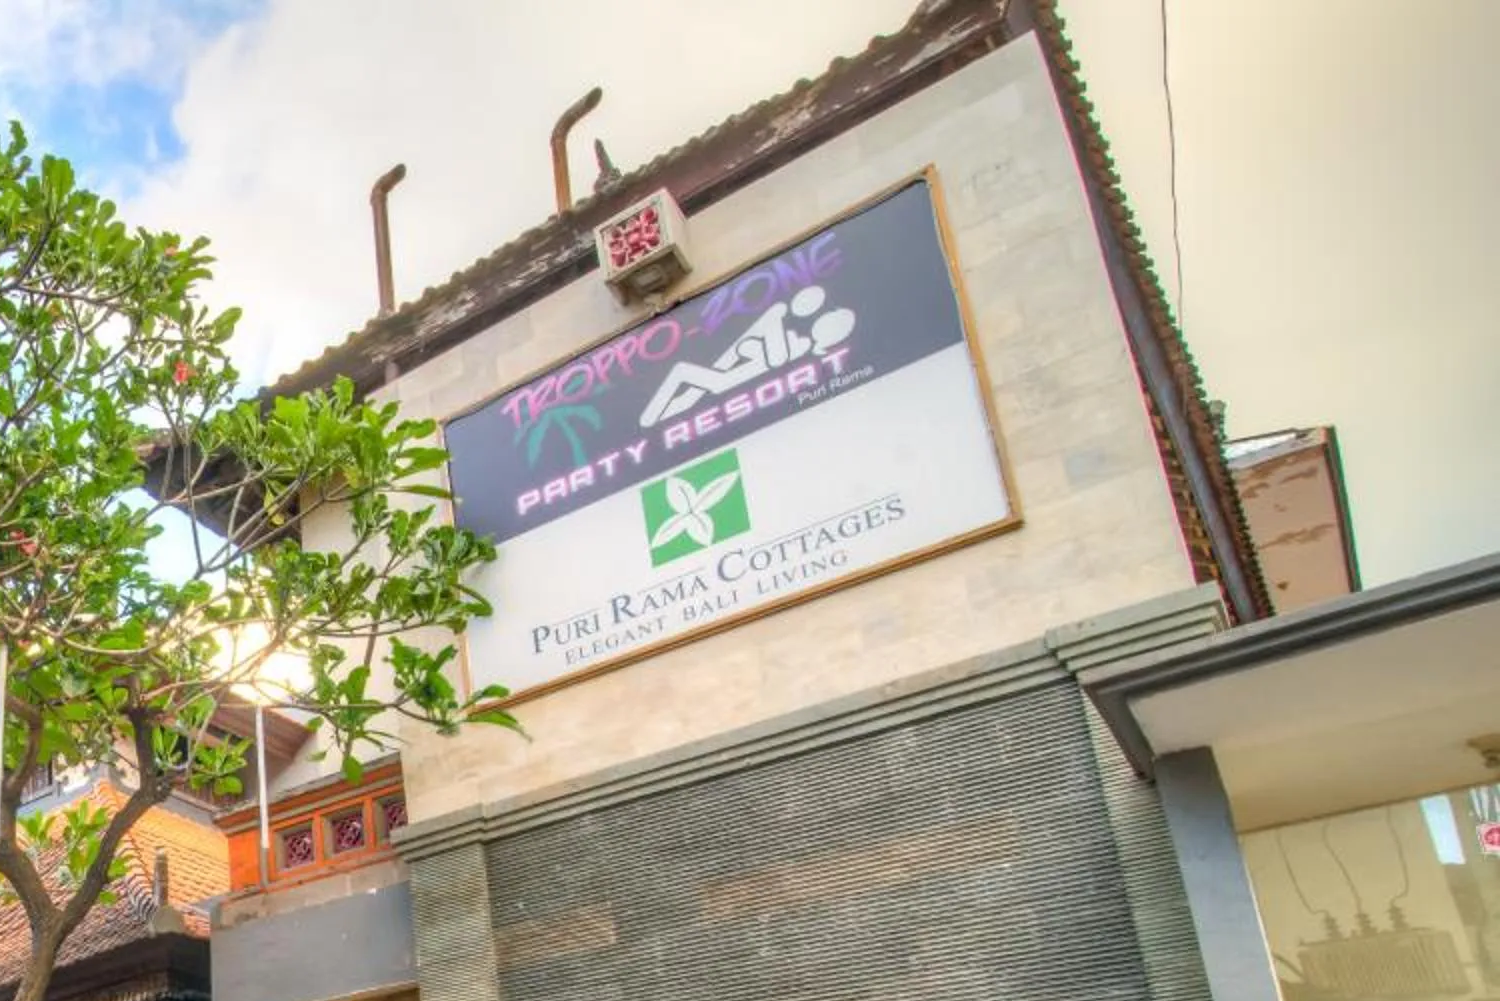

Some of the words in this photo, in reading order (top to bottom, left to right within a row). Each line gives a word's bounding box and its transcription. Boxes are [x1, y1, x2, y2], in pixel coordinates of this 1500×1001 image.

[516, 440, 649, 515] PARTY
[664, 347, 850, 449] RESORT
[797, 384, 827, 405] Puri
[531, 614, 600, 654] PURI
[611, 575, 709, 624] RAMA
[717, 498, 907, 582] COTTAGES
[565, 619, 667, 665] ELEGANT
[683, 590, 740, 621] BALI
[757, 550, 848, 595] LIVING
